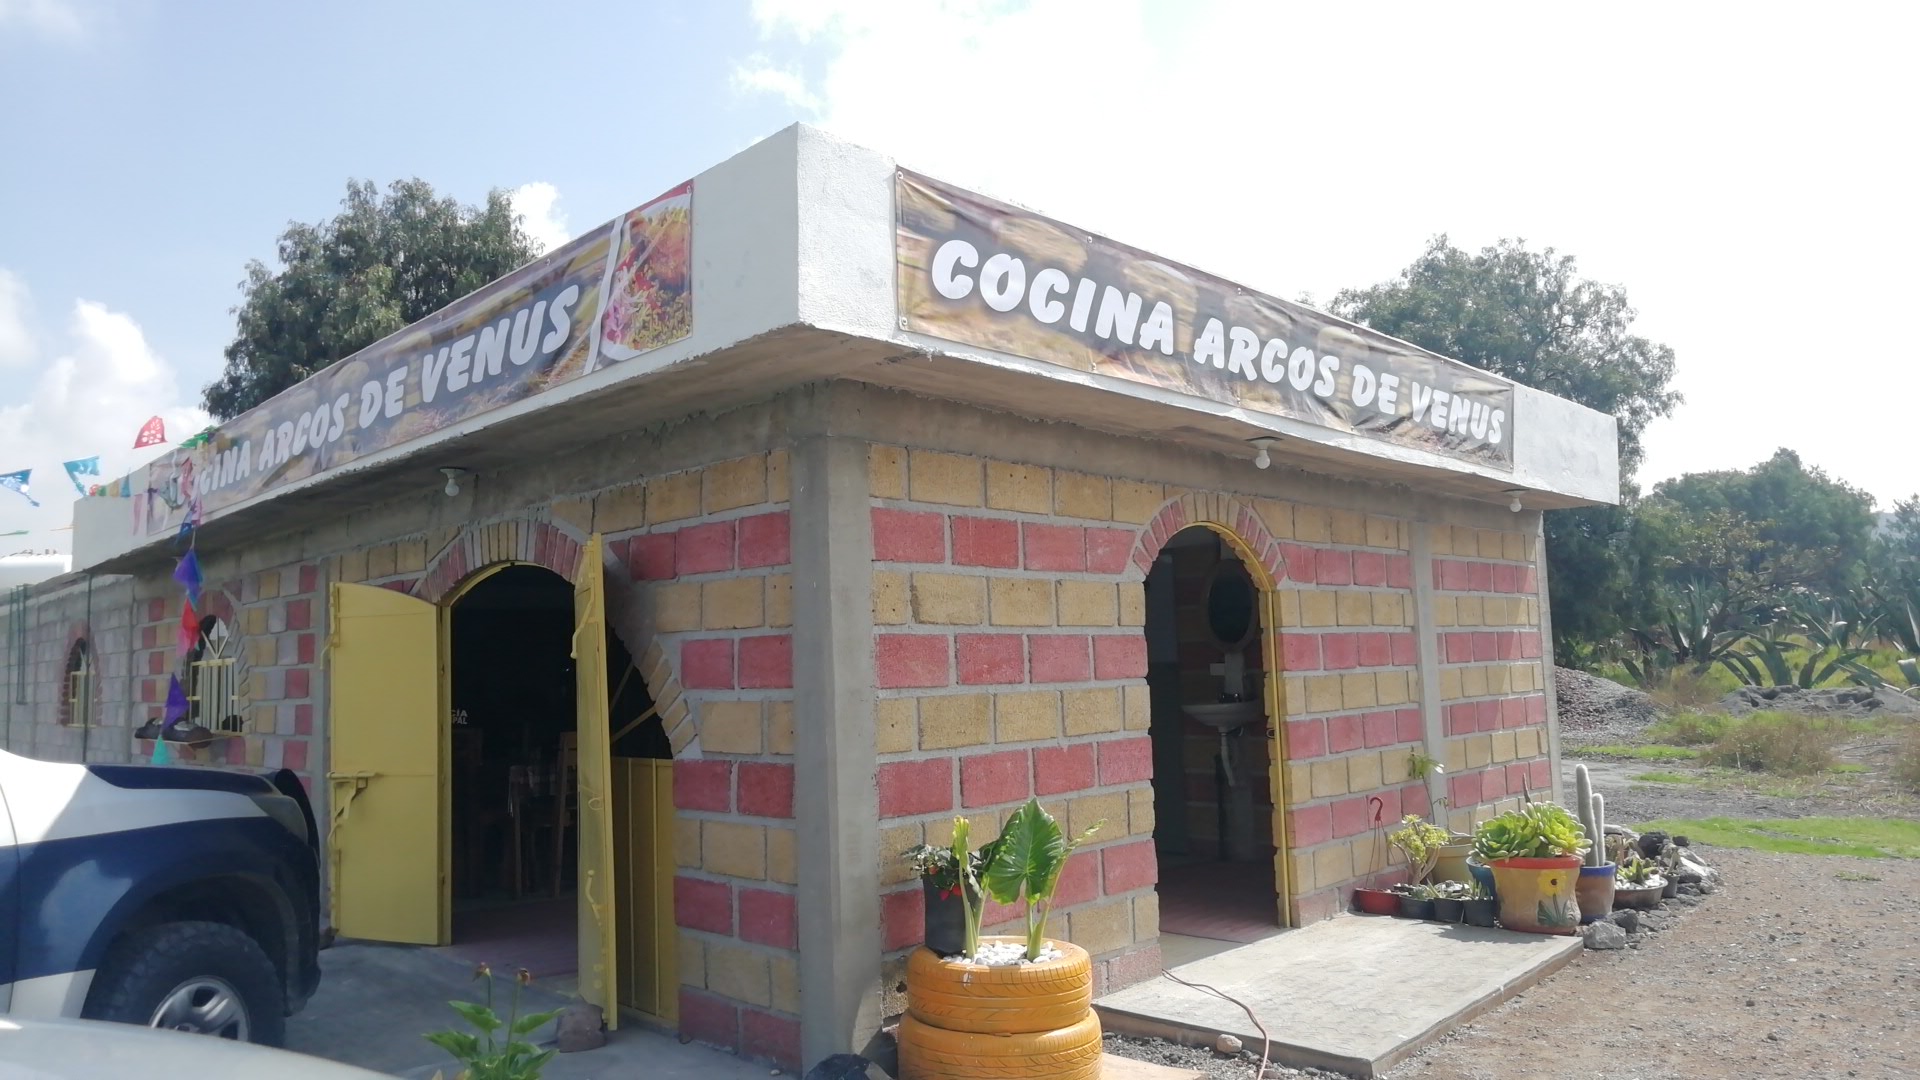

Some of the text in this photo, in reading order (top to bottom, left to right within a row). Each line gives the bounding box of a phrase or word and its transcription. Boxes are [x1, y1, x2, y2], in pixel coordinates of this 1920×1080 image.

[258, 393, 350, 471] ARCOS
[359, 366, 408, 429] DE
[421, 284, 579, 403] VENUS
[931, 239, 1506, 444] COCINA ARCOS DE VENUS
